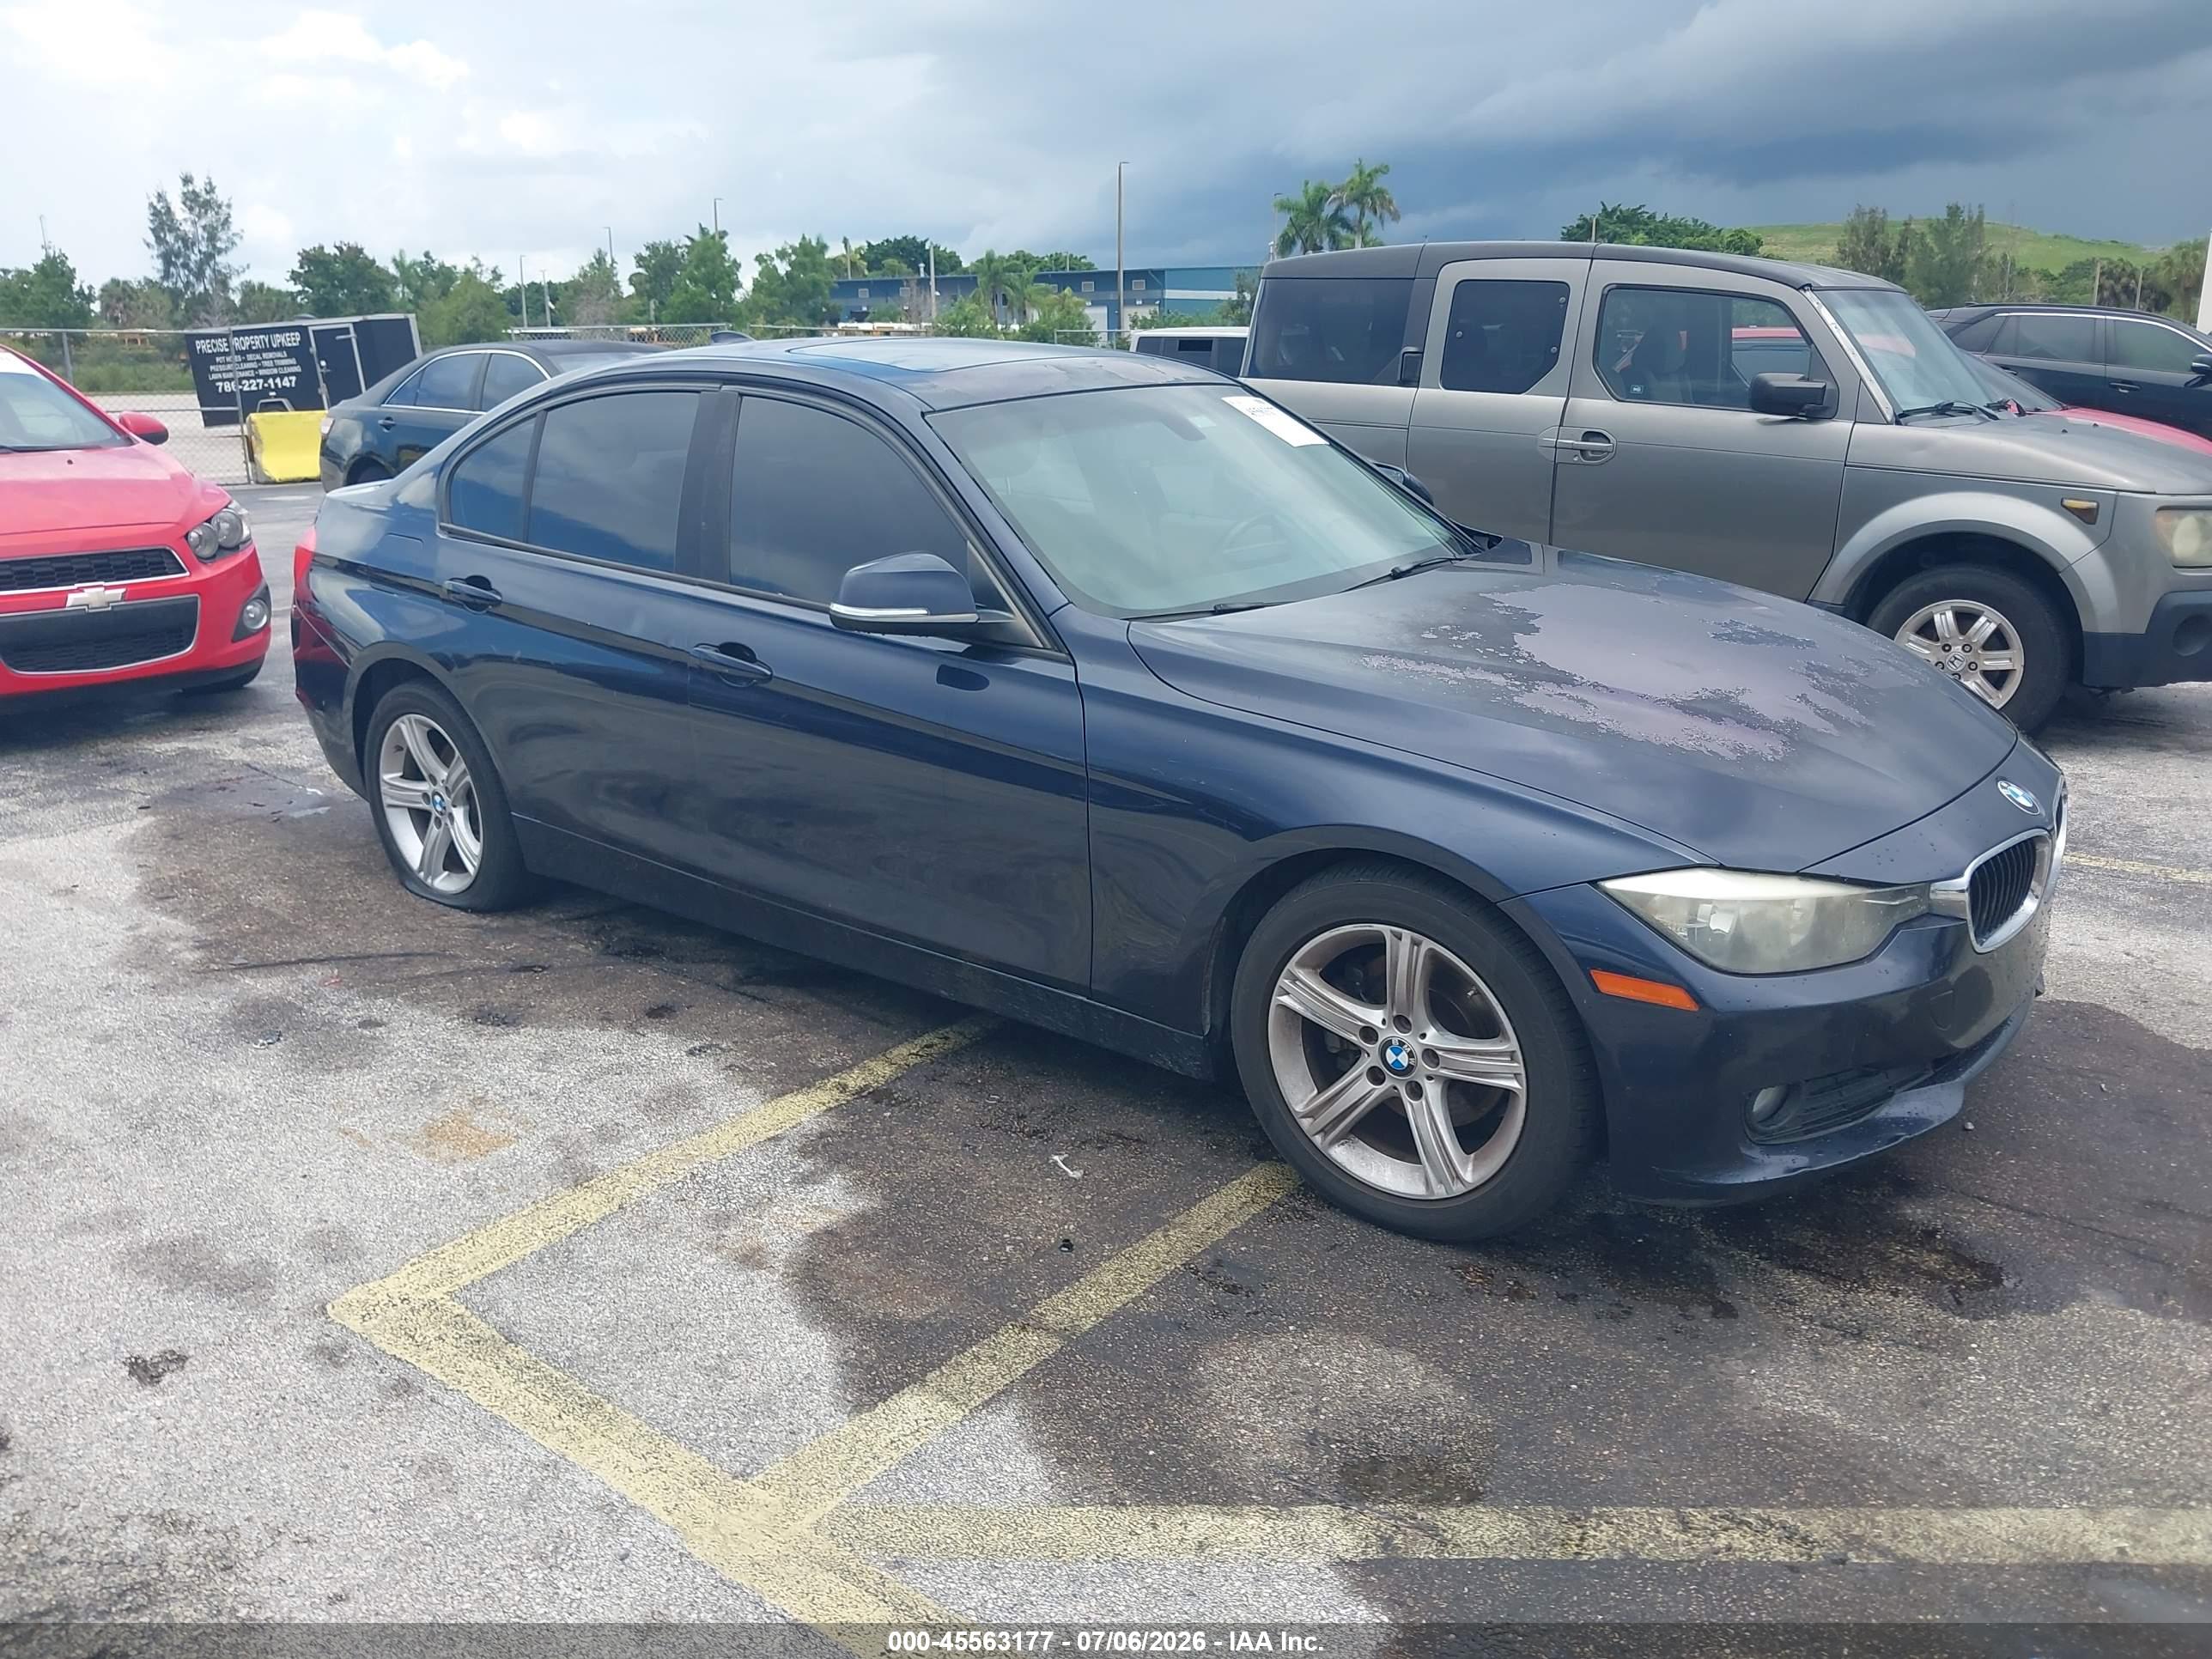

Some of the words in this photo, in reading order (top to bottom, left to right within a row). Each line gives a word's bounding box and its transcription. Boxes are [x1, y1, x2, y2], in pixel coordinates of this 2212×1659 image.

[195, 337, 229, 354] PRECISE
[232, 335, 269, 351] ROPERTY
[270, 331, 301, 348] UPKEEP
[210, 363, 234, 372] PRESSUR
